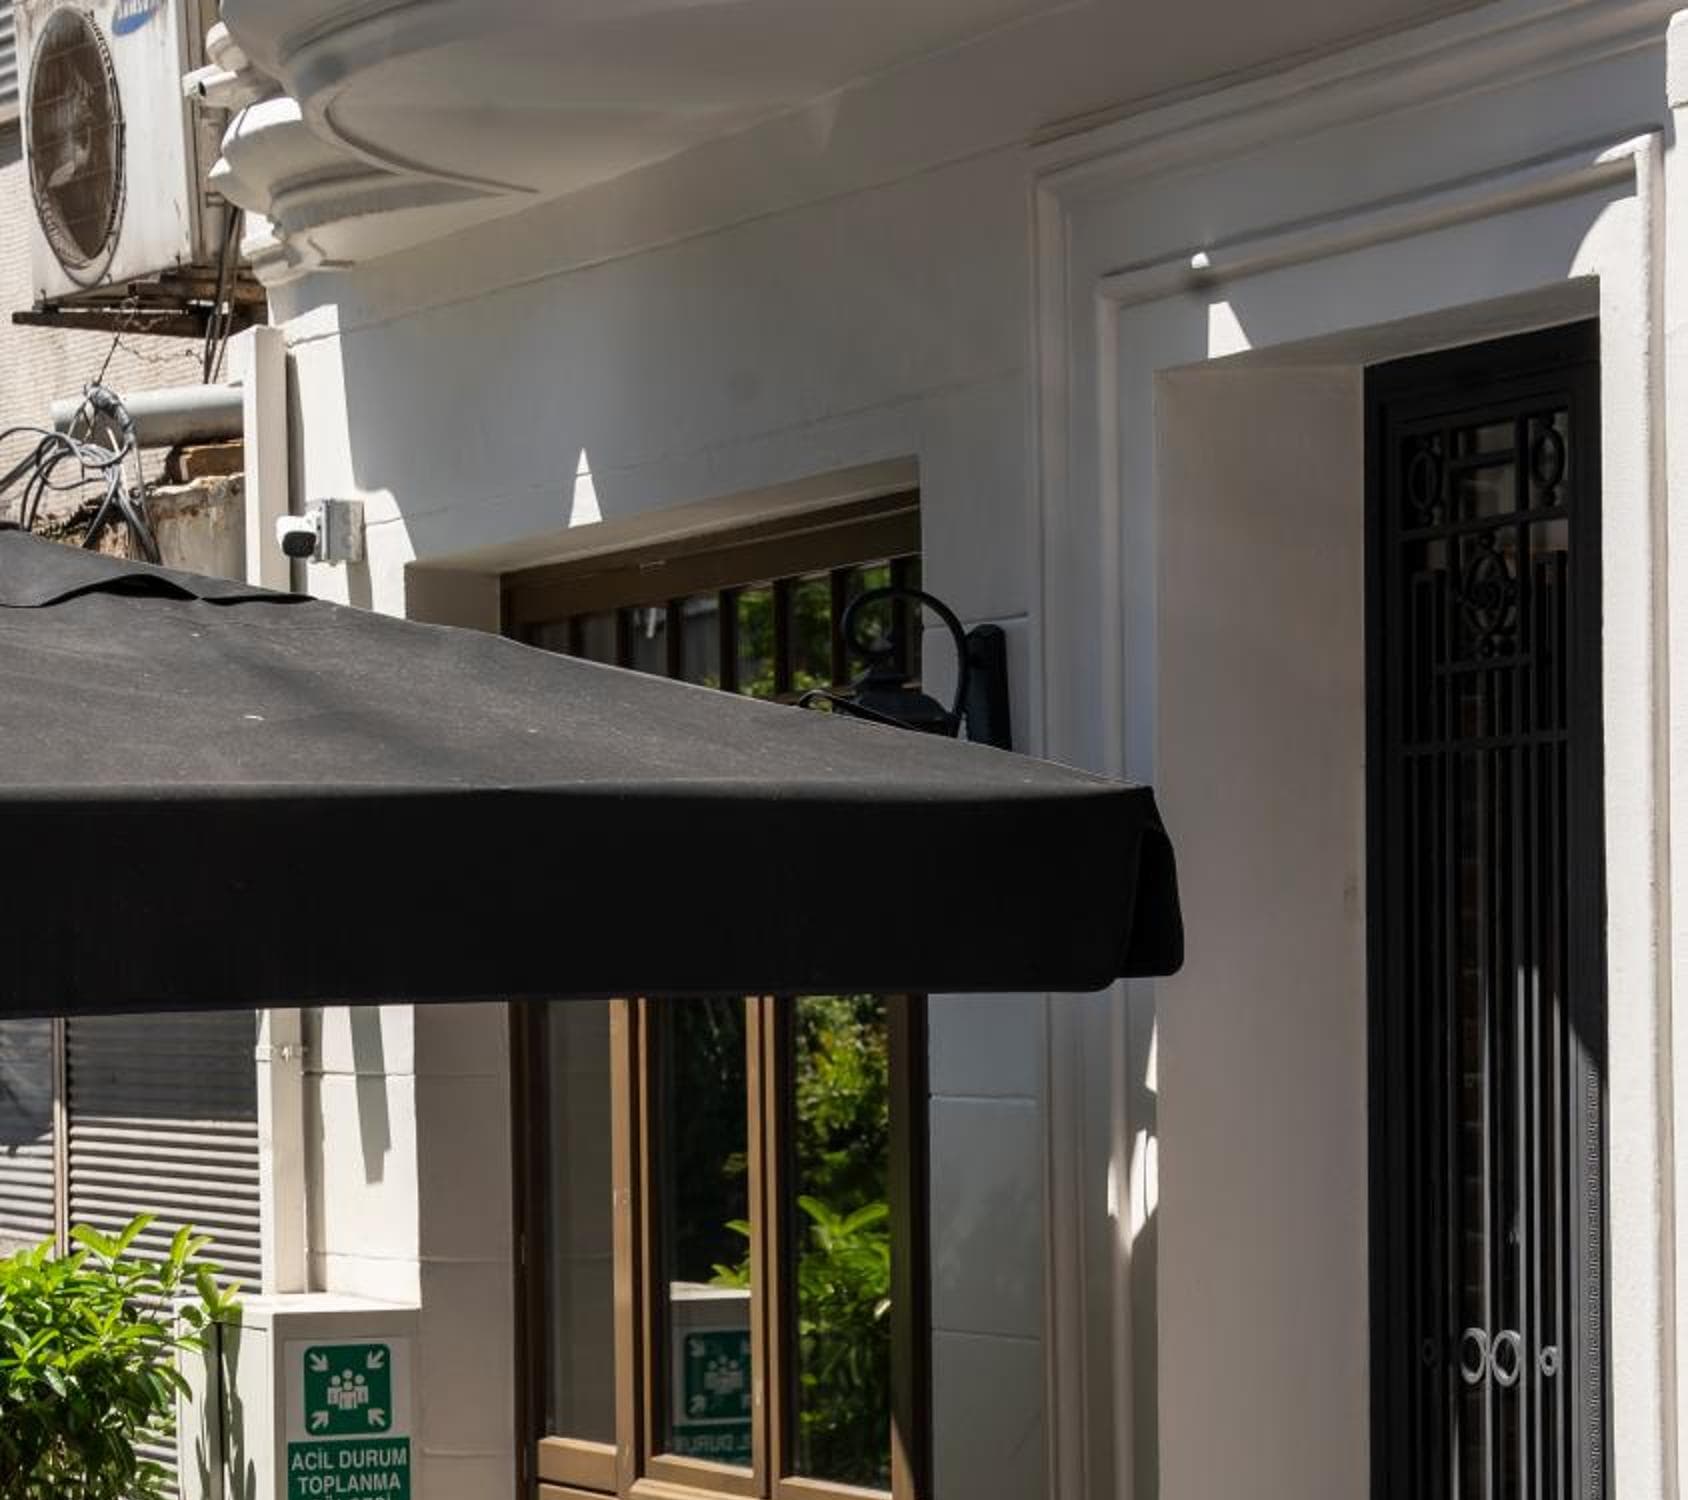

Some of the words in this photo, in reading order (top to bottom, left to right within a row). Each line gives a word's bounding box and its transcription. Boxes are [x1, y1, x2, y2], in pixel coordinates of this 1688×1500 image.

[291, 1448, 335, 1471] ACİL
[339, 1447, 408, 1469] DURUM
[298, 1472, 401, 1495] TOPLANMA
